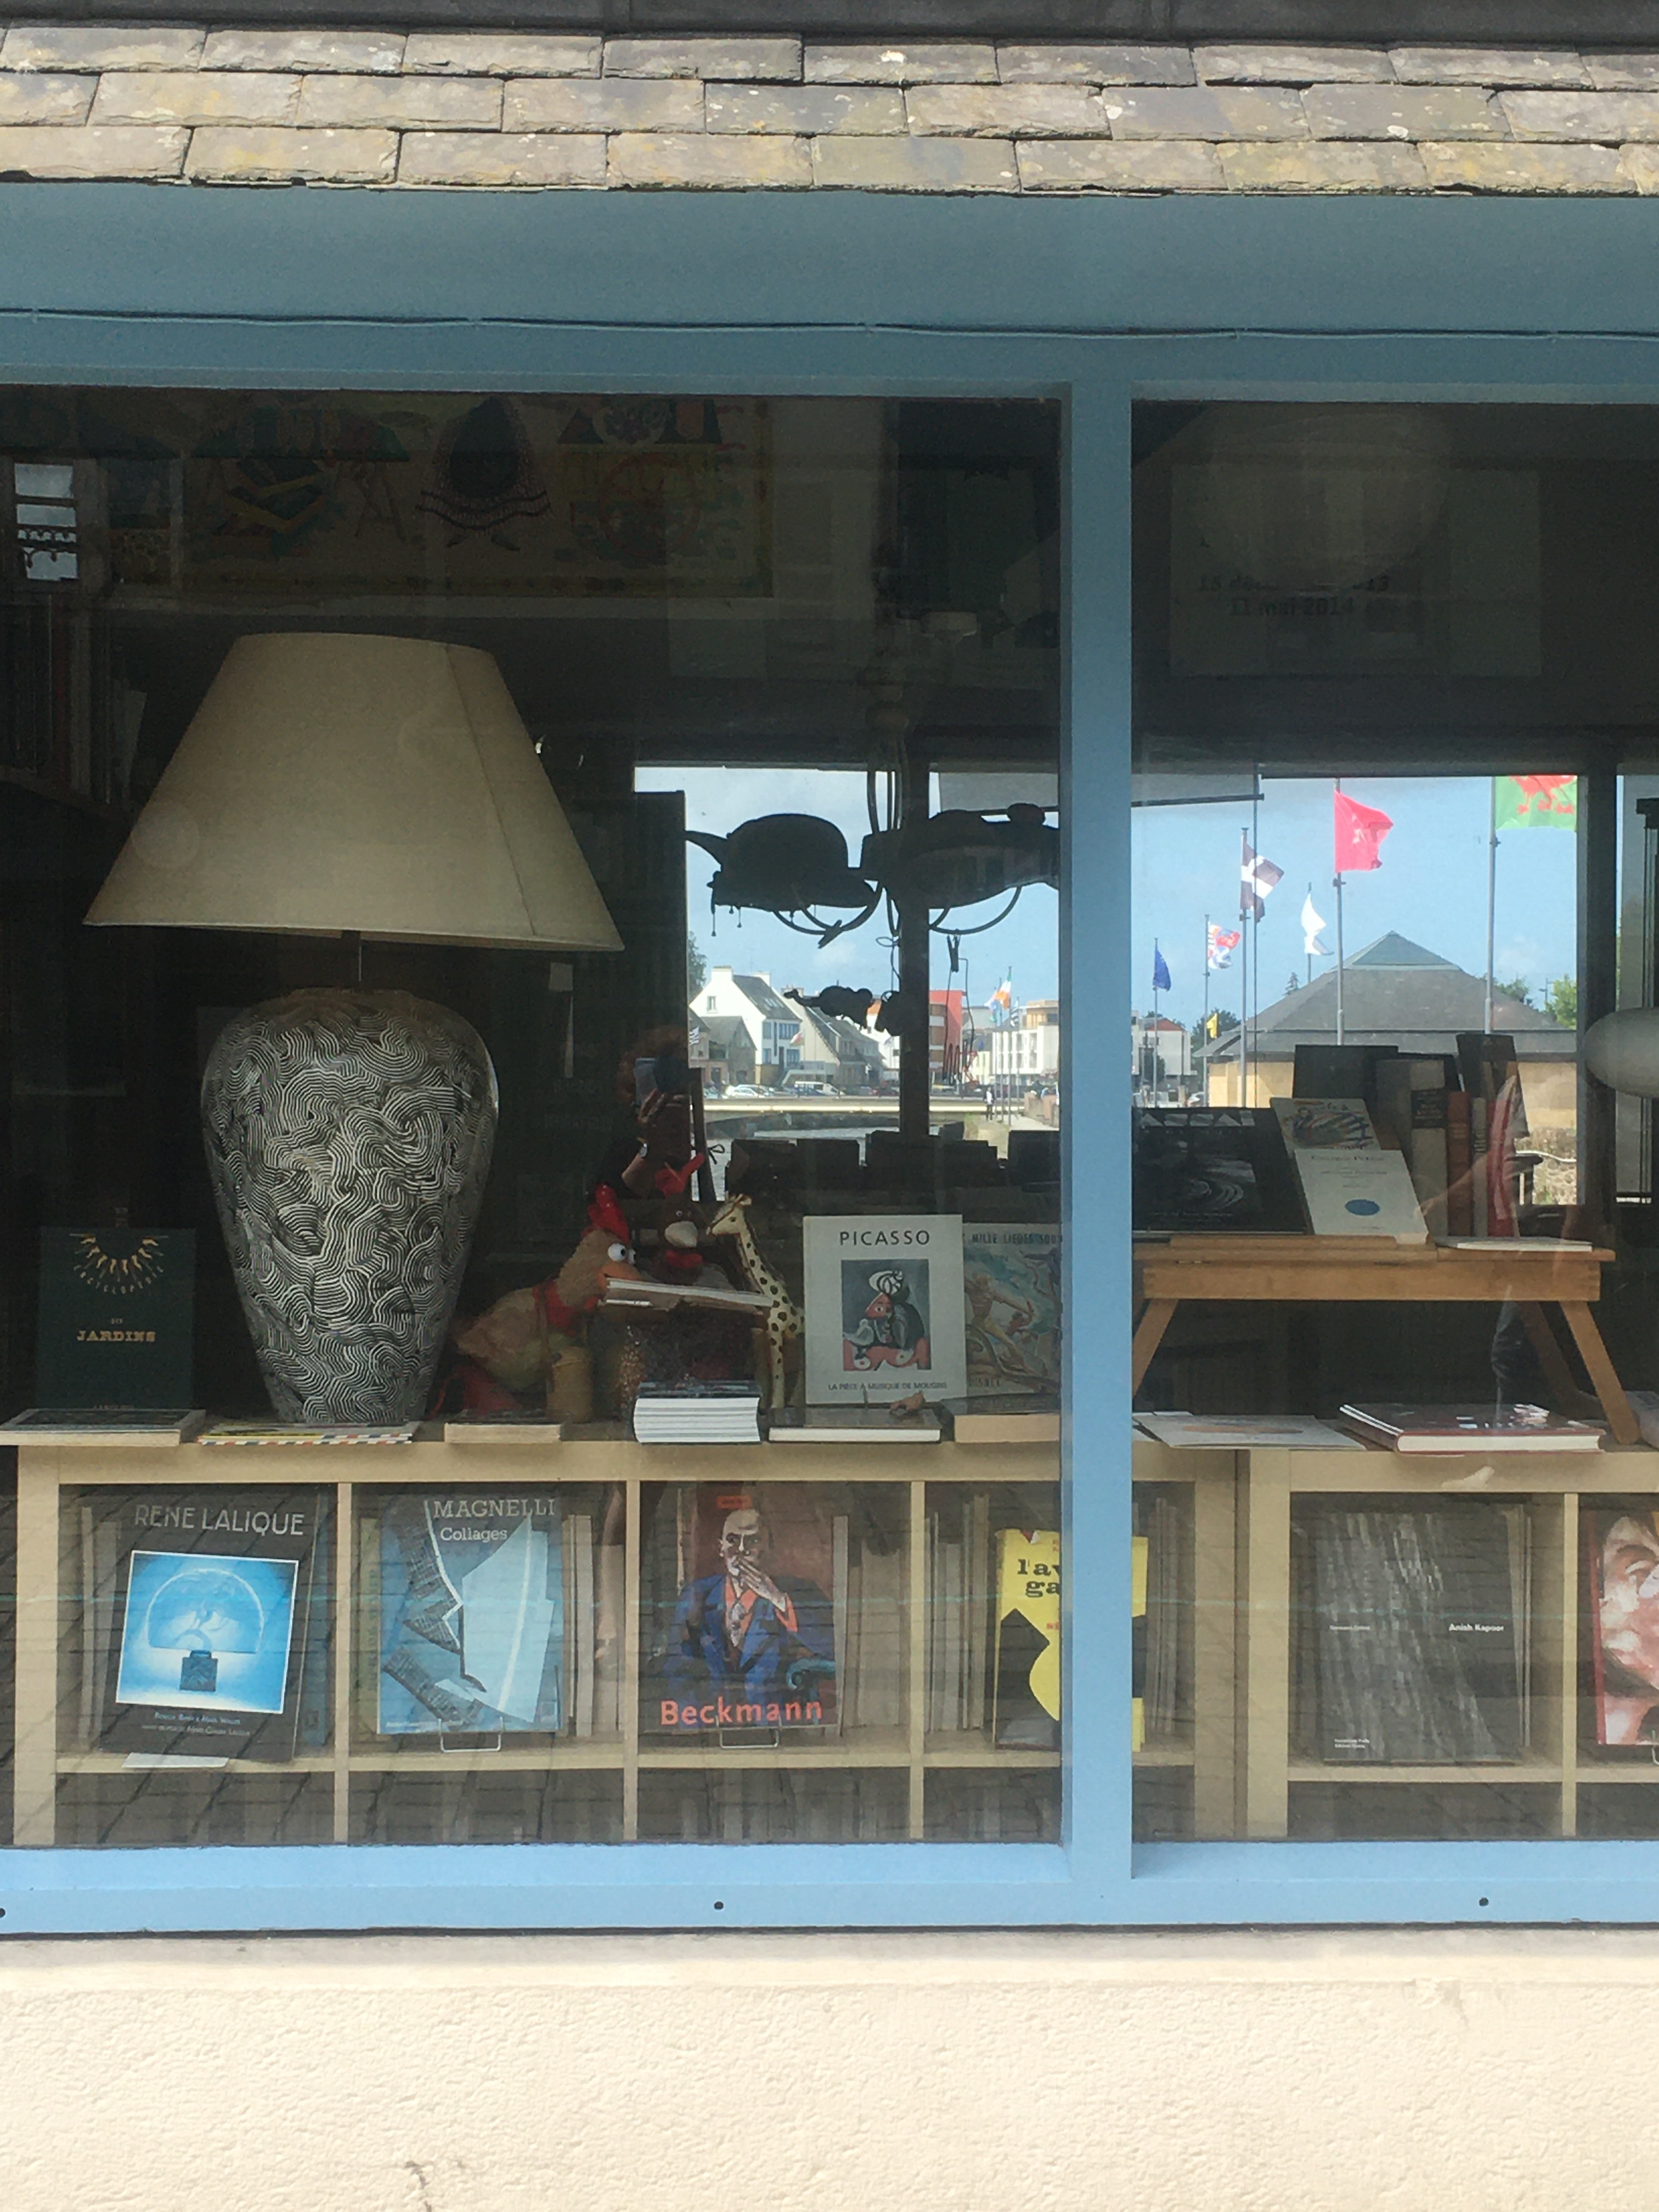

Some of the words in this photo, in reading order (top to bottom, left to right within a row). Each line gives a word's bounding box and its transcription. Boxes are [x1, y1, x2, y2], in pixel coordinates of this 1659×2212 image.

[839, 1229, 930, 1246] PICASSO
[76, 1330, 156, 1342] JARDINS
[433, 1499, 555, 1519] MAGNELLI
[202, 1508, 304, 1536] LALIQUE
[440, 1527, 507, 1543] Collages
[1449, 1623, 1474, 1632] Anish
[1475, 1623, 1504, 1633] Kapoor
[661, 1696, 822, 1725] Beckmann
